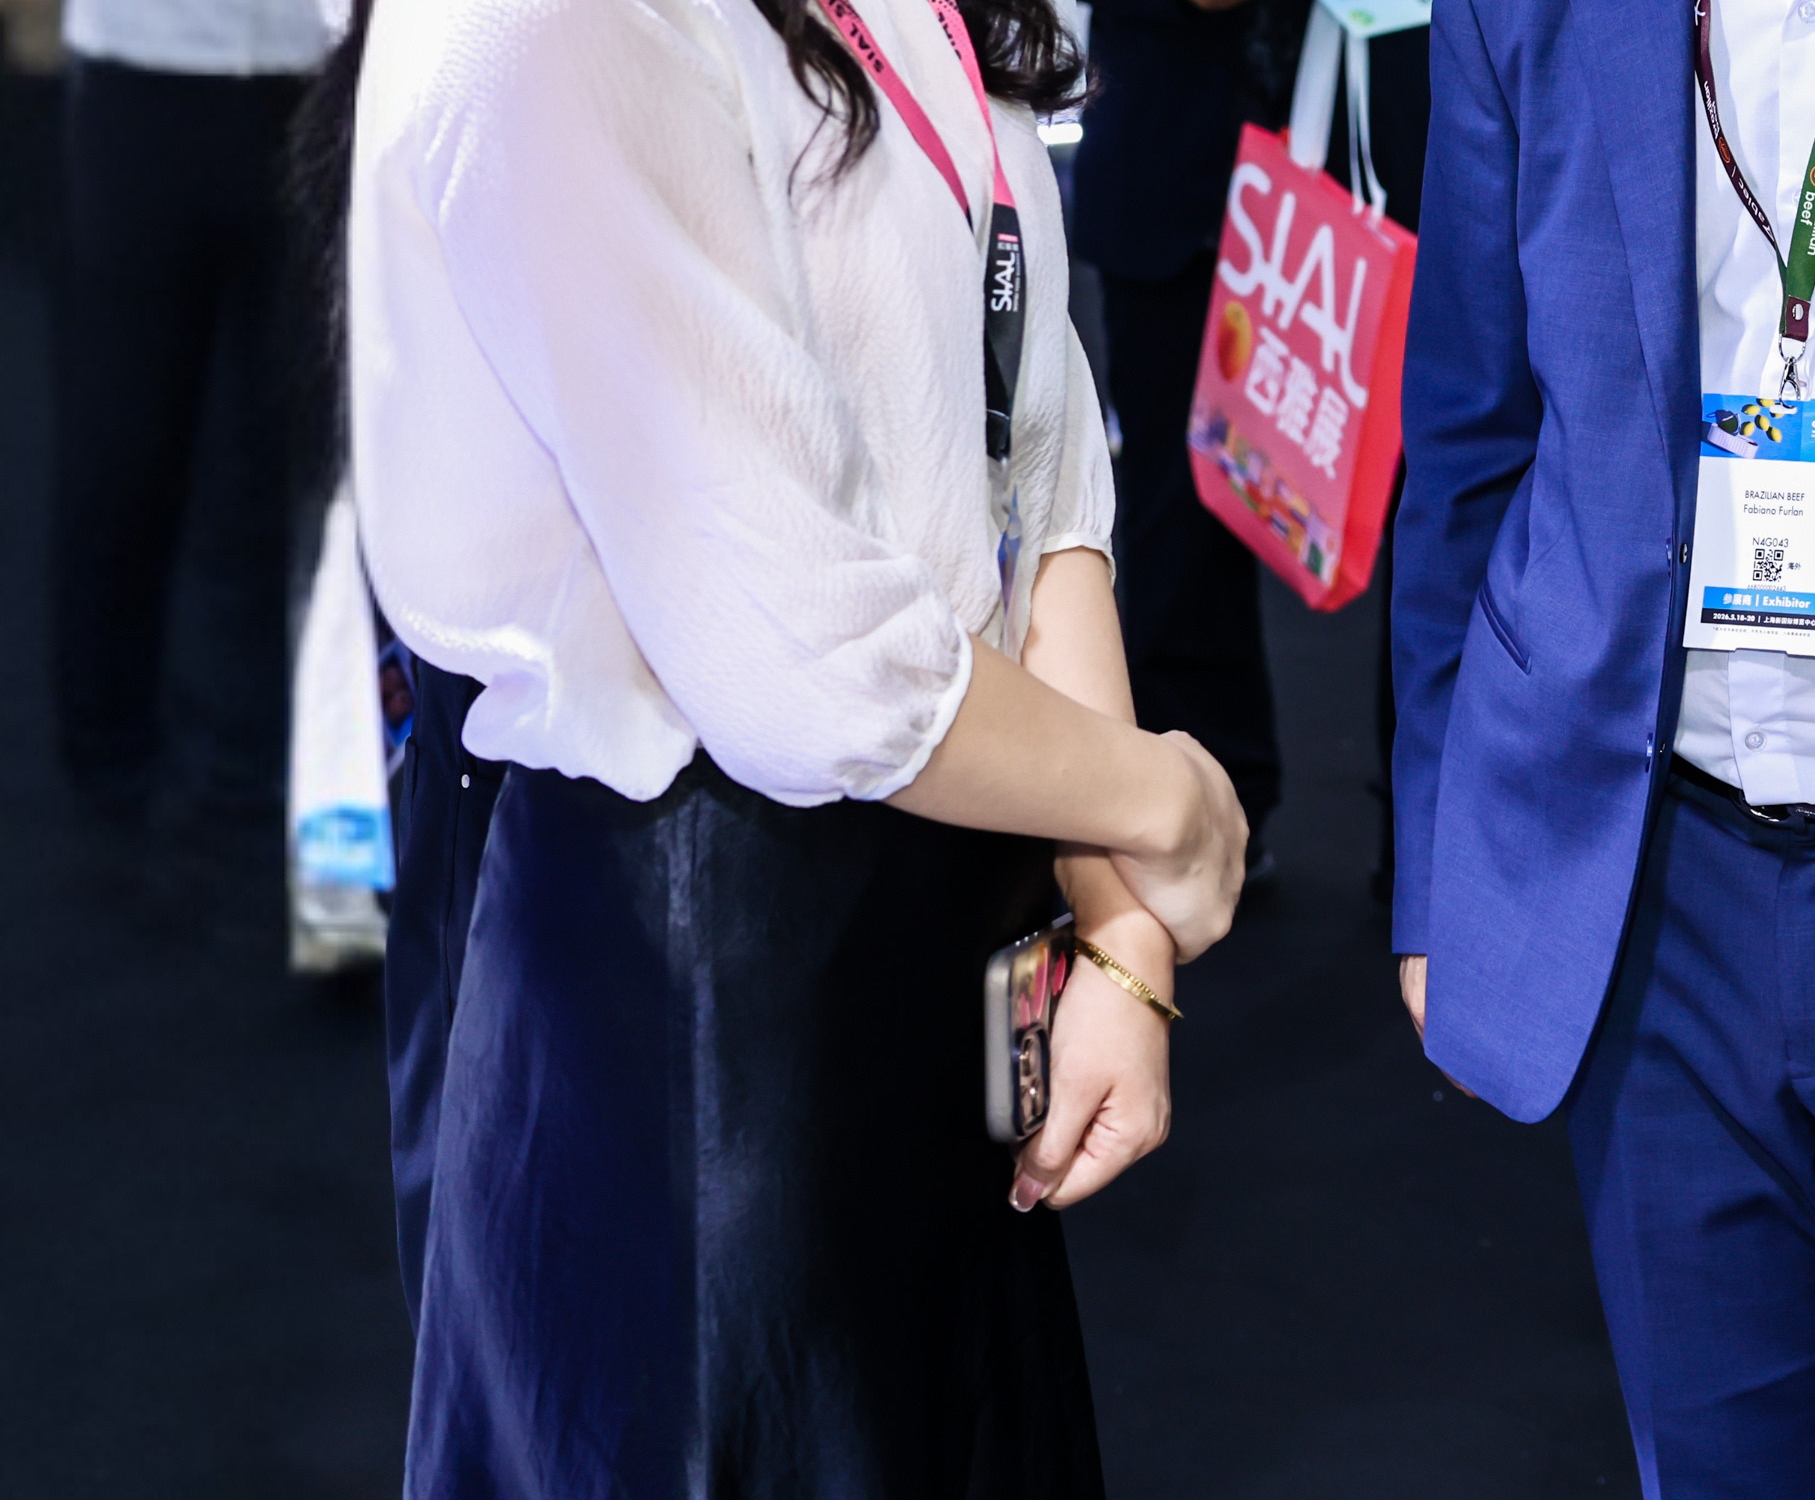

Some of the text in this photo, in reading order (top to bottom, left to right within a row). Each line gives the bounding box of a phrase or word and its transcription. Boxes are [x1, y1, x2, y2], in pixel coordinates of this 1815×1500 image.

[850, 22, 884, 74] SIAL
[1738, 177, 1766, 223] abiec
[990, 252, 1015, 312] SIAL
[1217, 161, 1368, 409] SIAL
[1743, 504, 1804, 516] Fabiano Furlan
[1744, 490, 1805, 502] BRAZILIAN BEEF
[1752, 537, 1789, 548] N4G043
[1722, 593, 1811, 609] 参展商 Exhibitor
